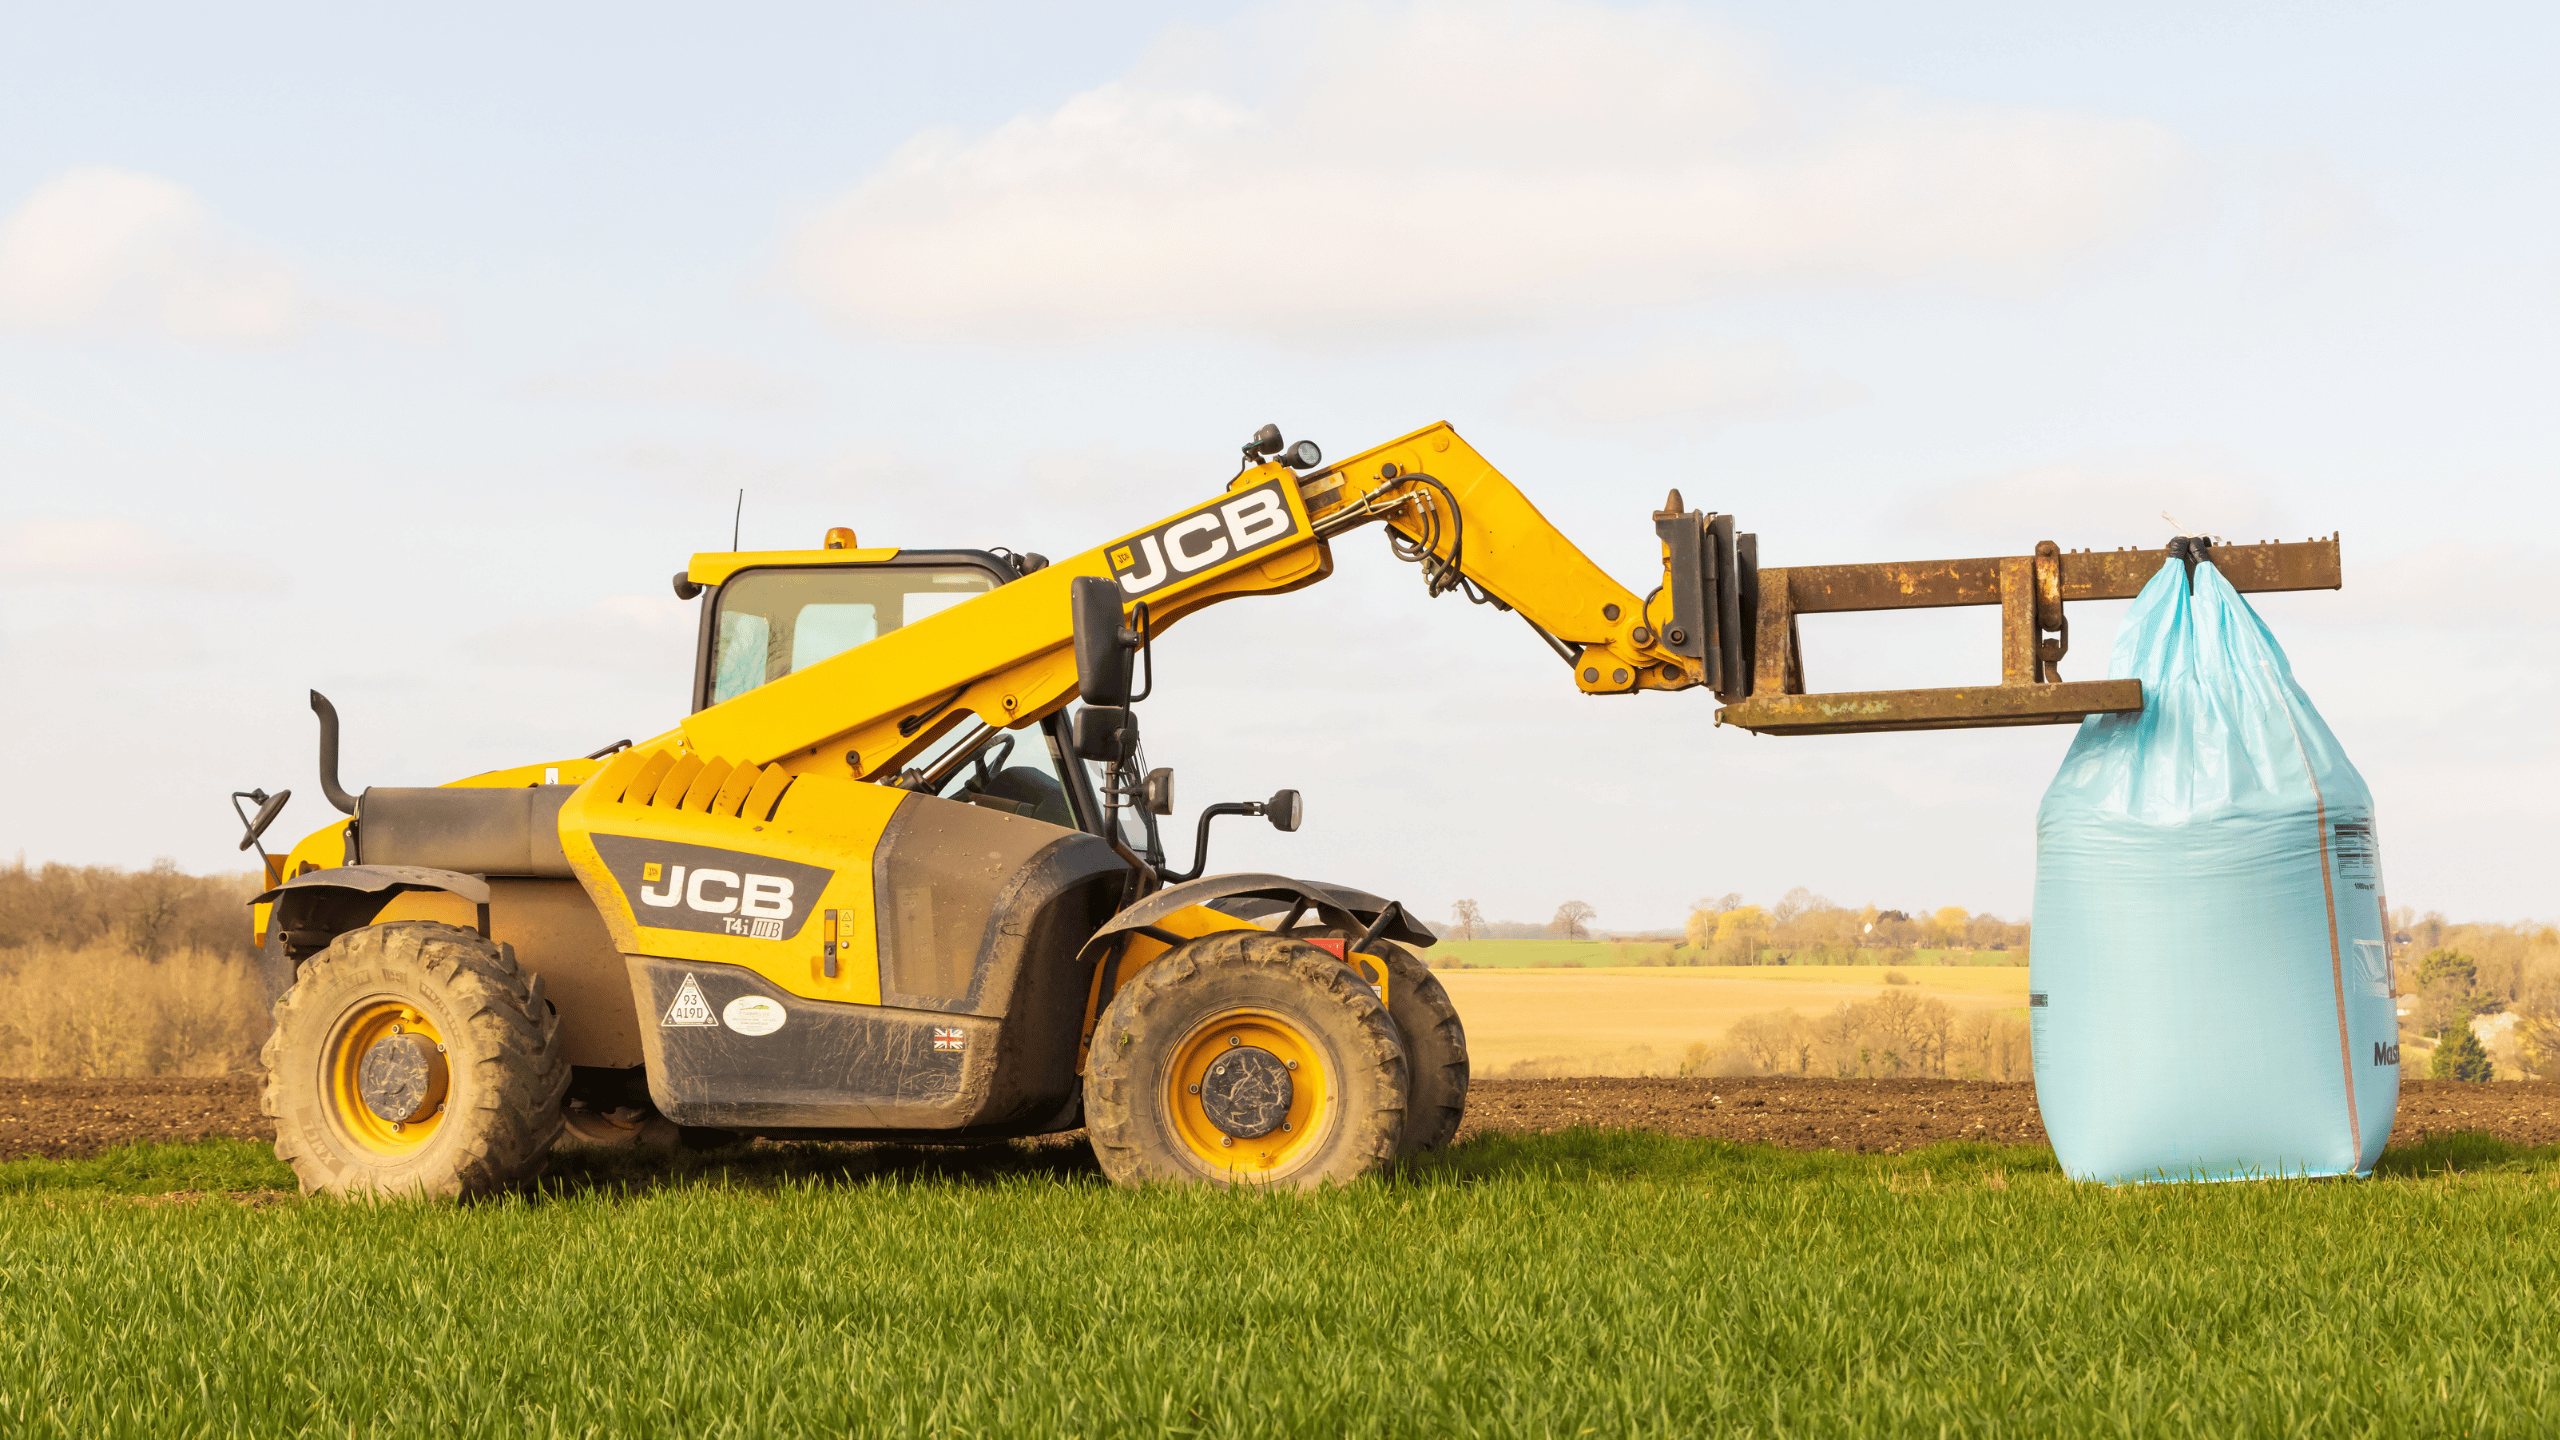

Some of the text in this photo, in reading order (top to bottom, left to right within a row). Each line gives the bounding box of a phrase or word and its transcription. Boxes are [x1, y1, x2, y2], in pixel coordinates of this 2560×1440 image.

[1119, 488, 1290, 594] JCB
[640, 865, 795, 920] JCB
[723, 917, 749, 936] T4i
[684, 995, 697, 1006] 93
